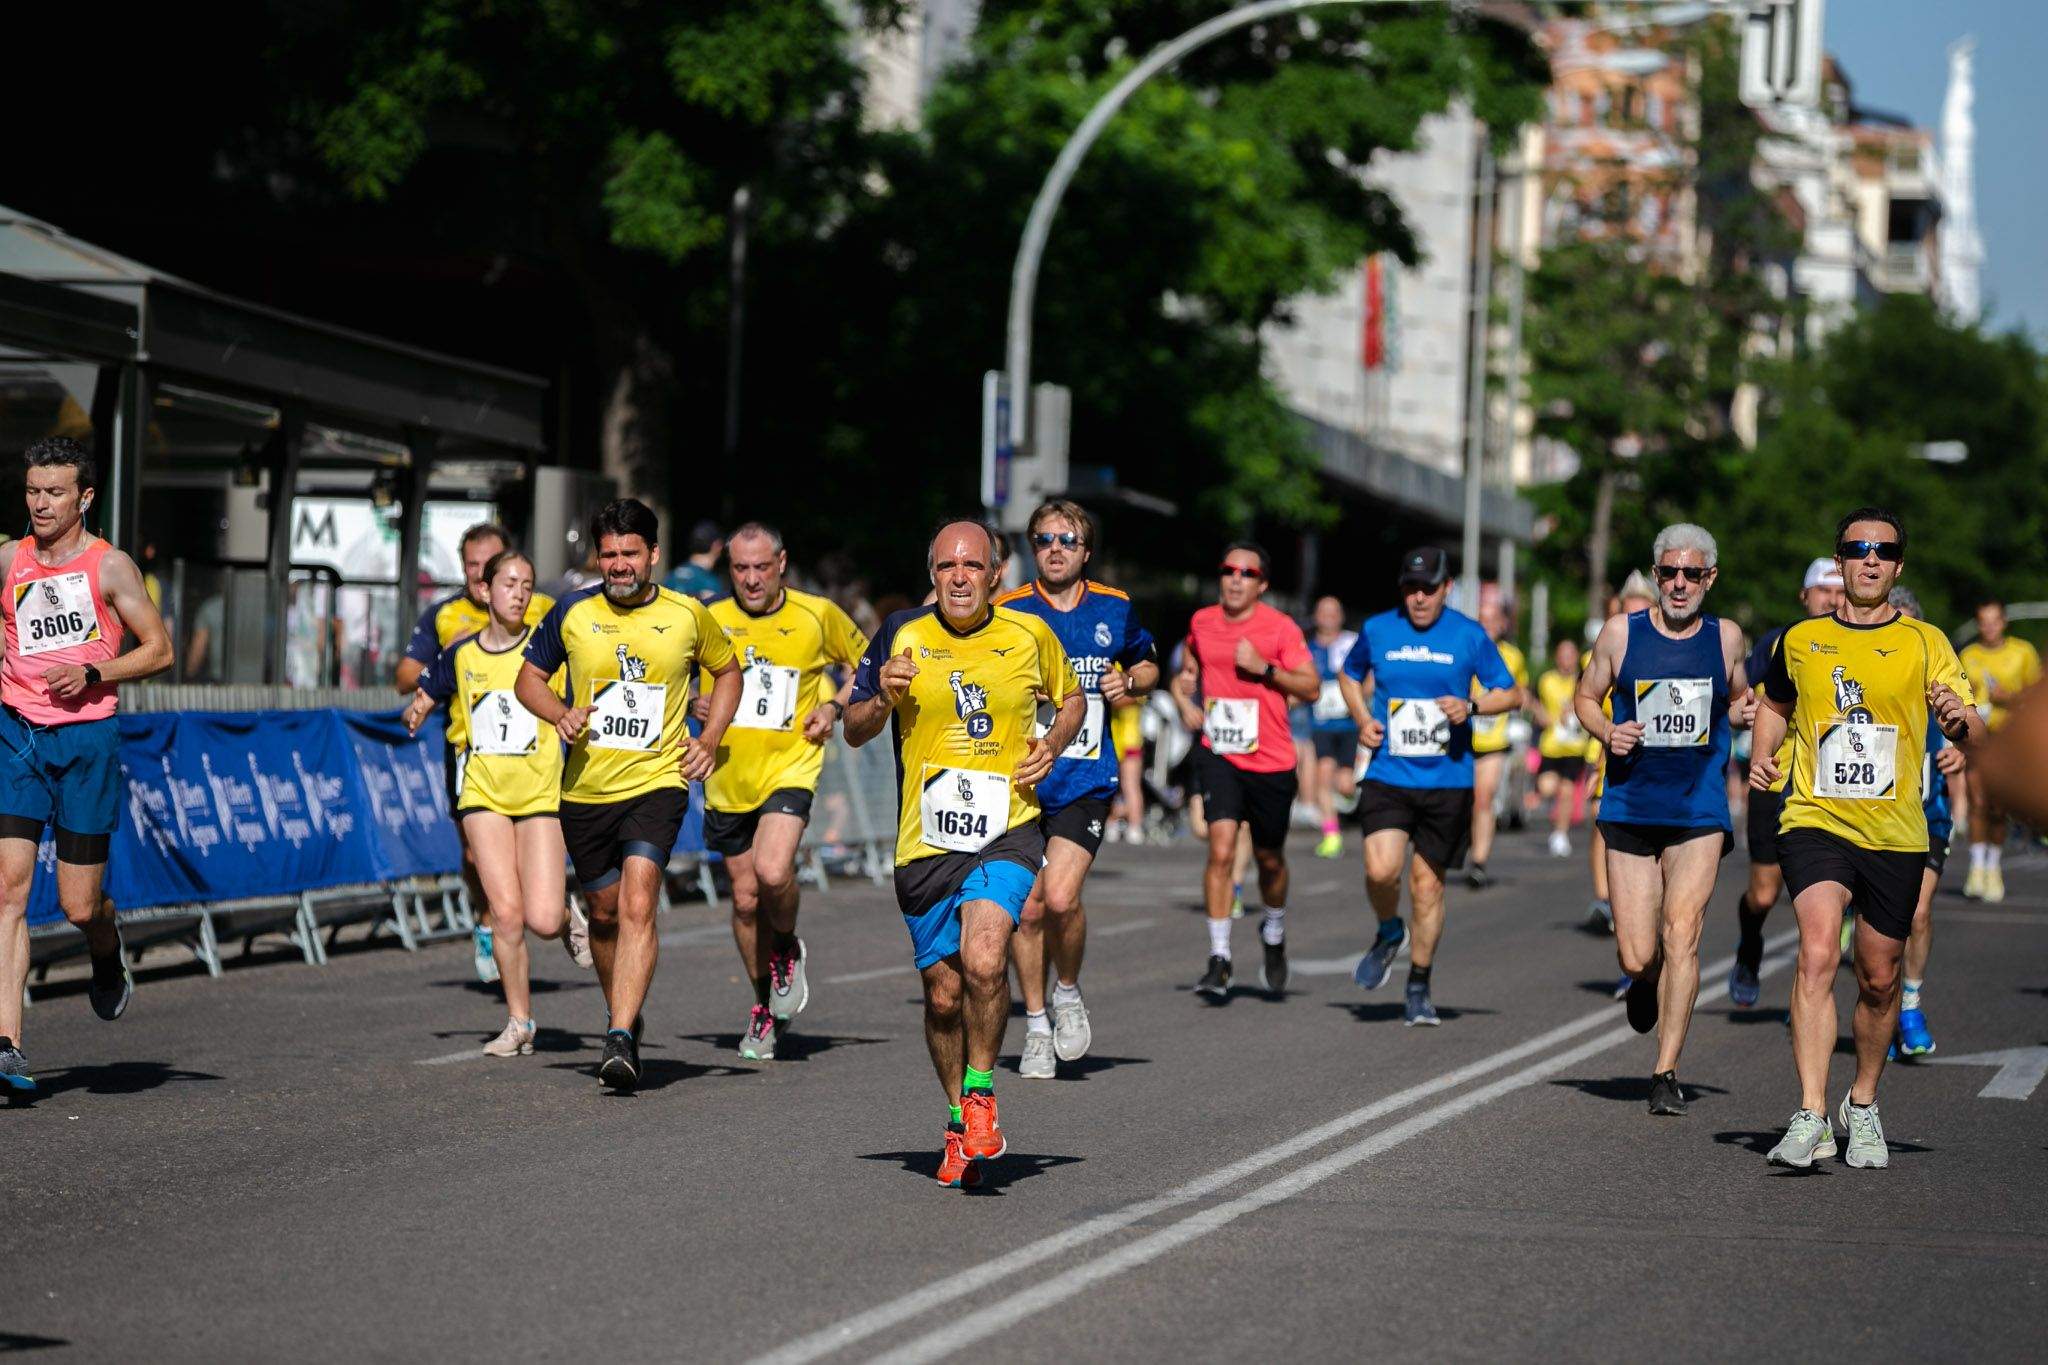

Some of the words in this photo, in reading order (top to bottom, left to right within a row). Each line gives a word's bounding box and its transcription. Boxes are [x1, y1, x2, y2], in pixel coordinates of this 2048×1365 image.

[296, 507, 338, 547] M
[30, 611, 84, 640] 3606
[756, 698, 768, 716] 6
[602, 715, 650, 738] 3067
[972, 718, 988, 733] 13
[1652, 714, 1696, 734] 1299
[1852, 713, 1868, 724] 13
[499, 724, 508, 742] 7
[1401, 728, 1438, 746] 1654
[974, 748, 1000, 756] Liberty
[1834, 762, 1875, 785] 528
[934, 809, 988, 838] 1634
